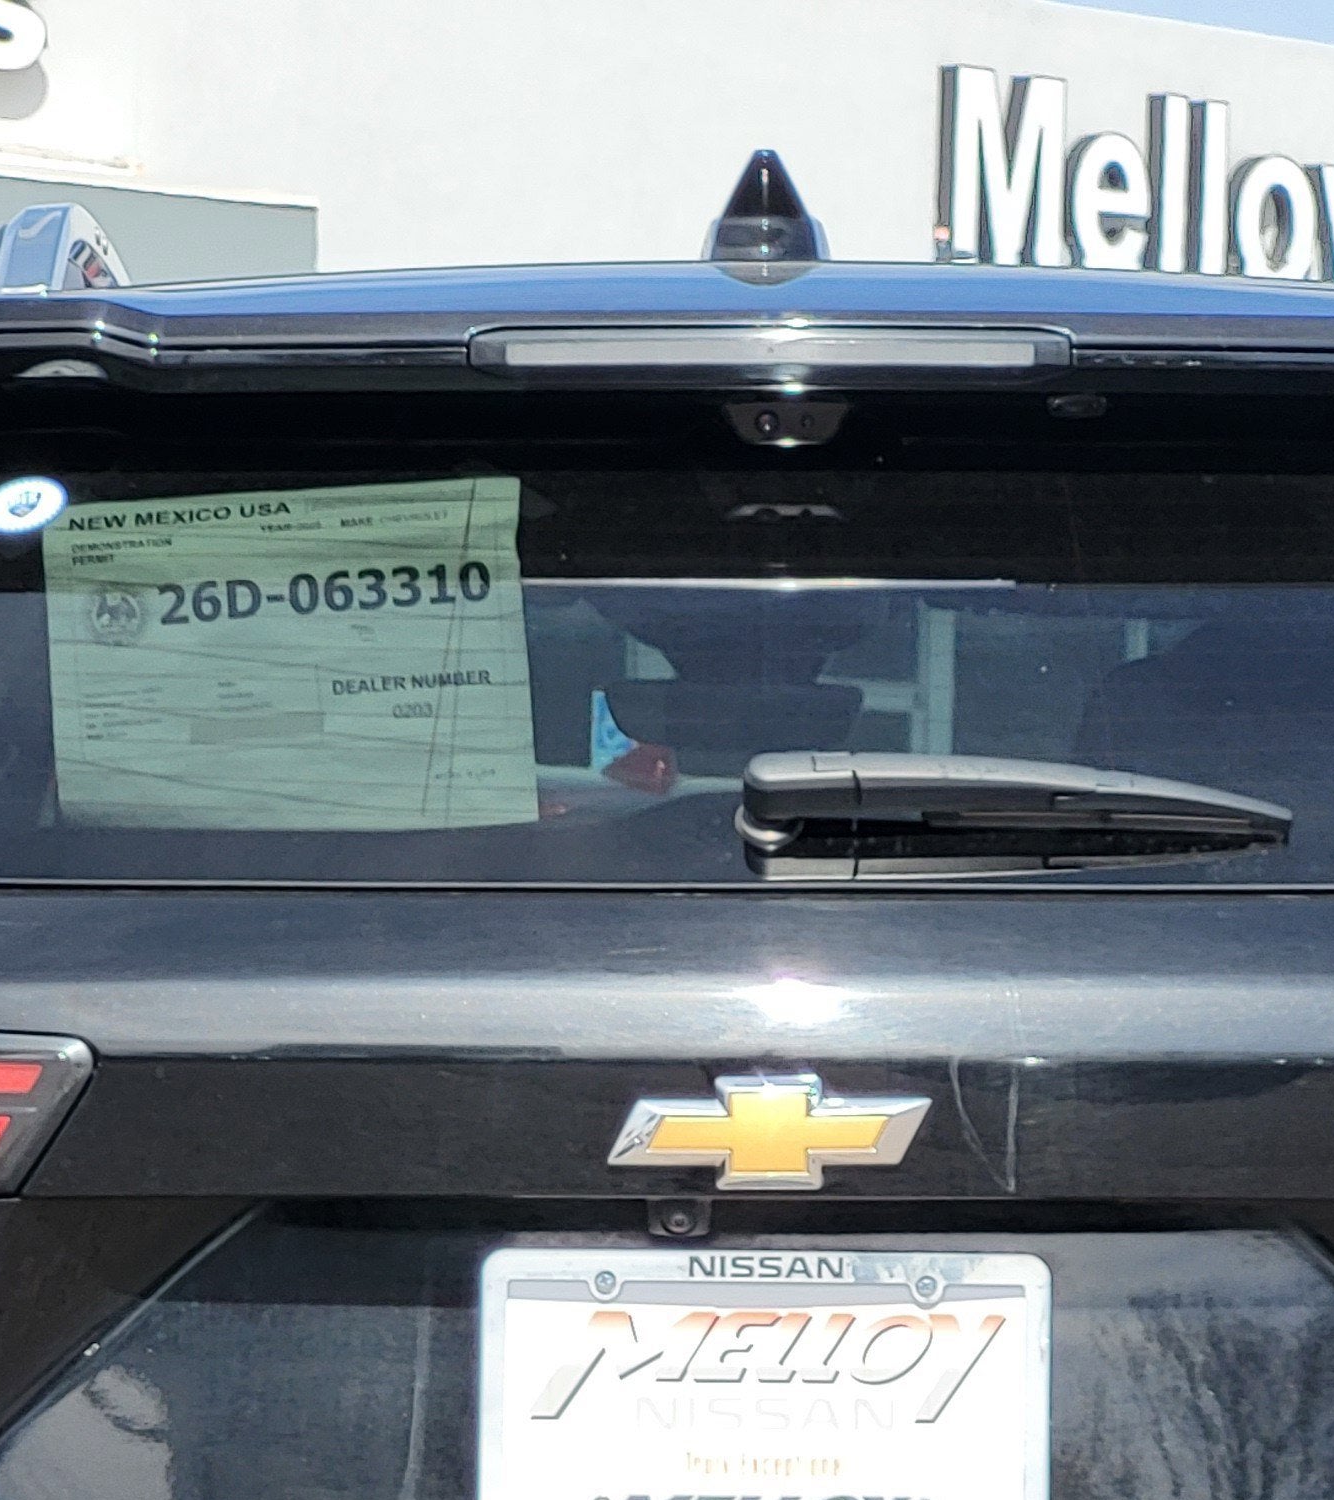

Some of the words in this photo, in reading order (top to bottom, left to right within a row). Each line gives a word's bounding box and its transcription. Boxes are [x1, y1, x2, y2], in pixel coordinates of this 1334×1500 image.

[68, 513, 127, 532] NEW
[134, 506, 232, 528] MEXICO
[239, 501, 292, 519] USA
[71, 537, 173, 554] DEMONSTRATION
[157, 560, 492, 626] 26D-063310
[331, 675, 407, 696] DEALER
[411, 669, 492, 690] NUMBER
[688, 1256, 845, 1280] NISSAN
[530, 1310, 1007, 1424] MELLOY
[635, 1397, 895, 1431] NISSAN
